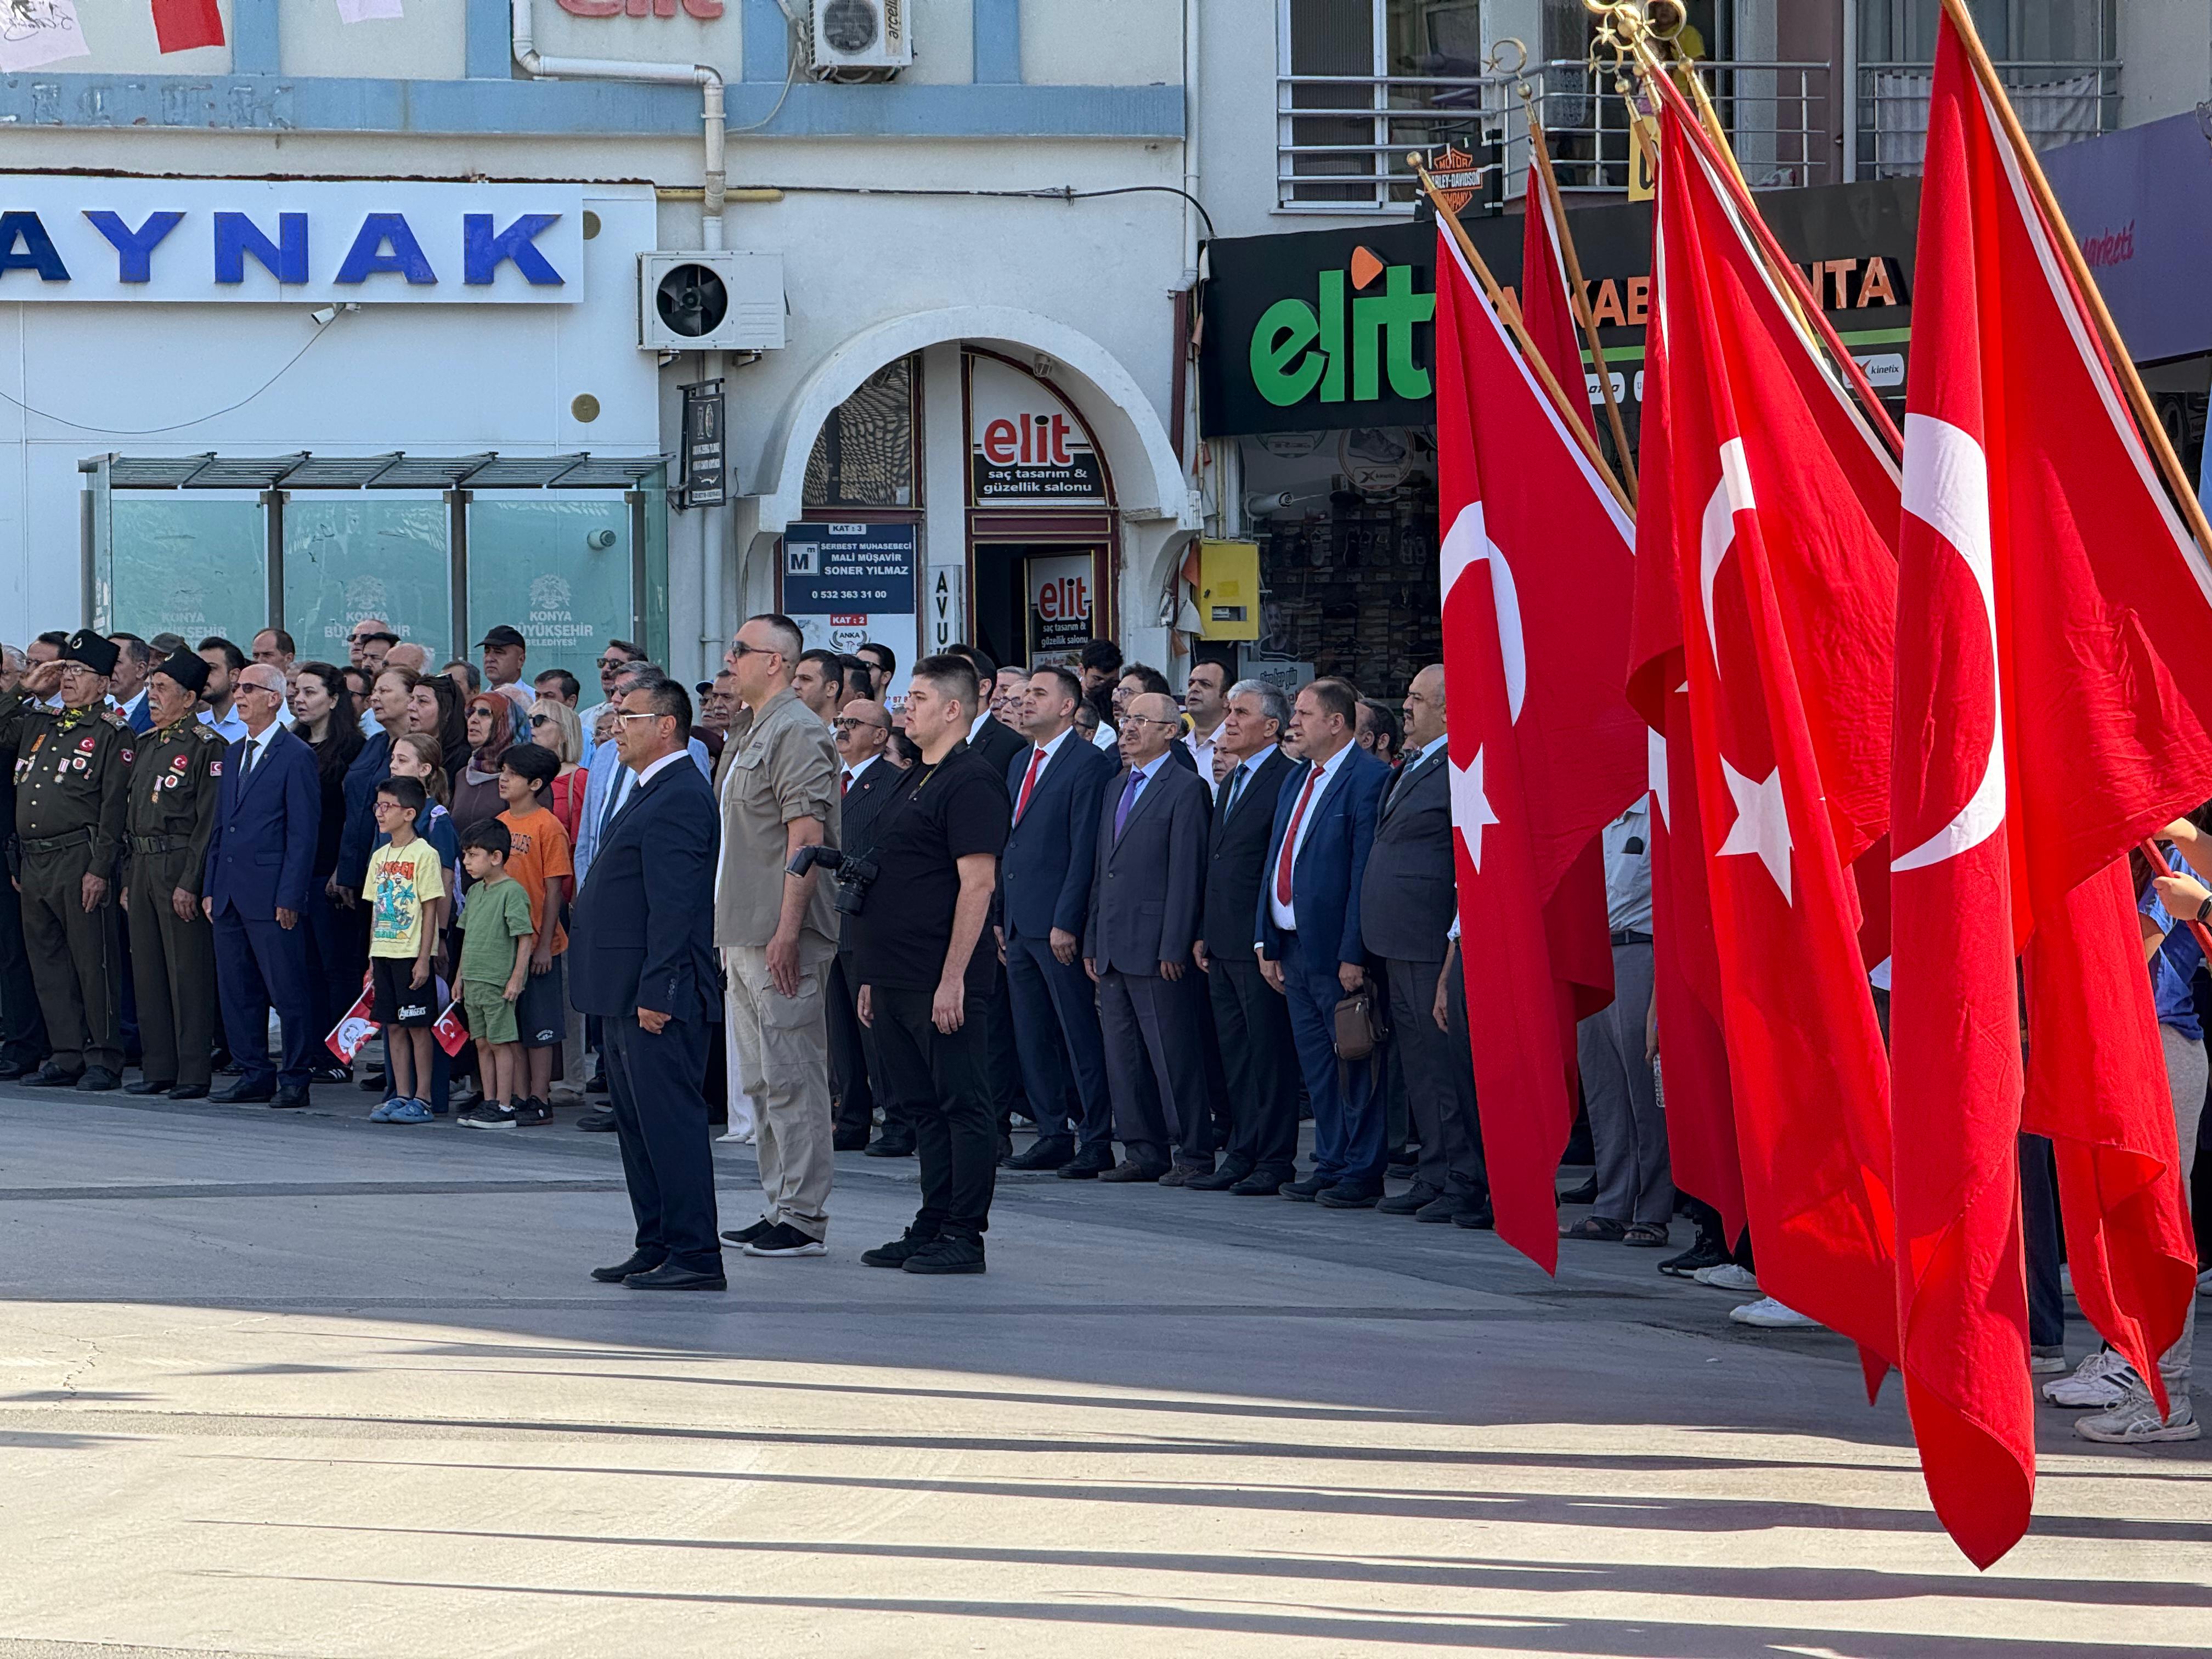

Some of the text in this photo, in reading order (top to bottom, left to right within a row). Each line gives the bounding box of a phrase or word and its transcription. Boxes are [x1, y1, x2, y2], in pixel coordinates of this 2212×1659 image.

[1439, 155, 1468, 169] MOTOR
[1250, 246, 1436, 407] elit
[1871, 364, 1899, 375] kinetix
[984, 414, 1070, 463] elit
[988, 469, 1087, 481] saç tasarım &
[983, 482, 1092, 494] güzellik salonu
[859, 541, 912, 550] MUHASEBECİ
[831, 552, 902, 563] MALİ MÜŞAVİR
[825, 566, 909, 575] SONER YILMAZ
[820, 590, 838, 599] 532
[840, 590, 858, 599] 363
[860, 590, 872, 599] 31
[874, 590, 887, 599] 00
[1039, 577, 1086, 618] elit
[161, 612, 205, 623] KONYA
[346, 612, 389, 622] KONYA
[529, 611, 572, 622] KONYA
[526, 637, 576, 646] BELEDİYESİ
